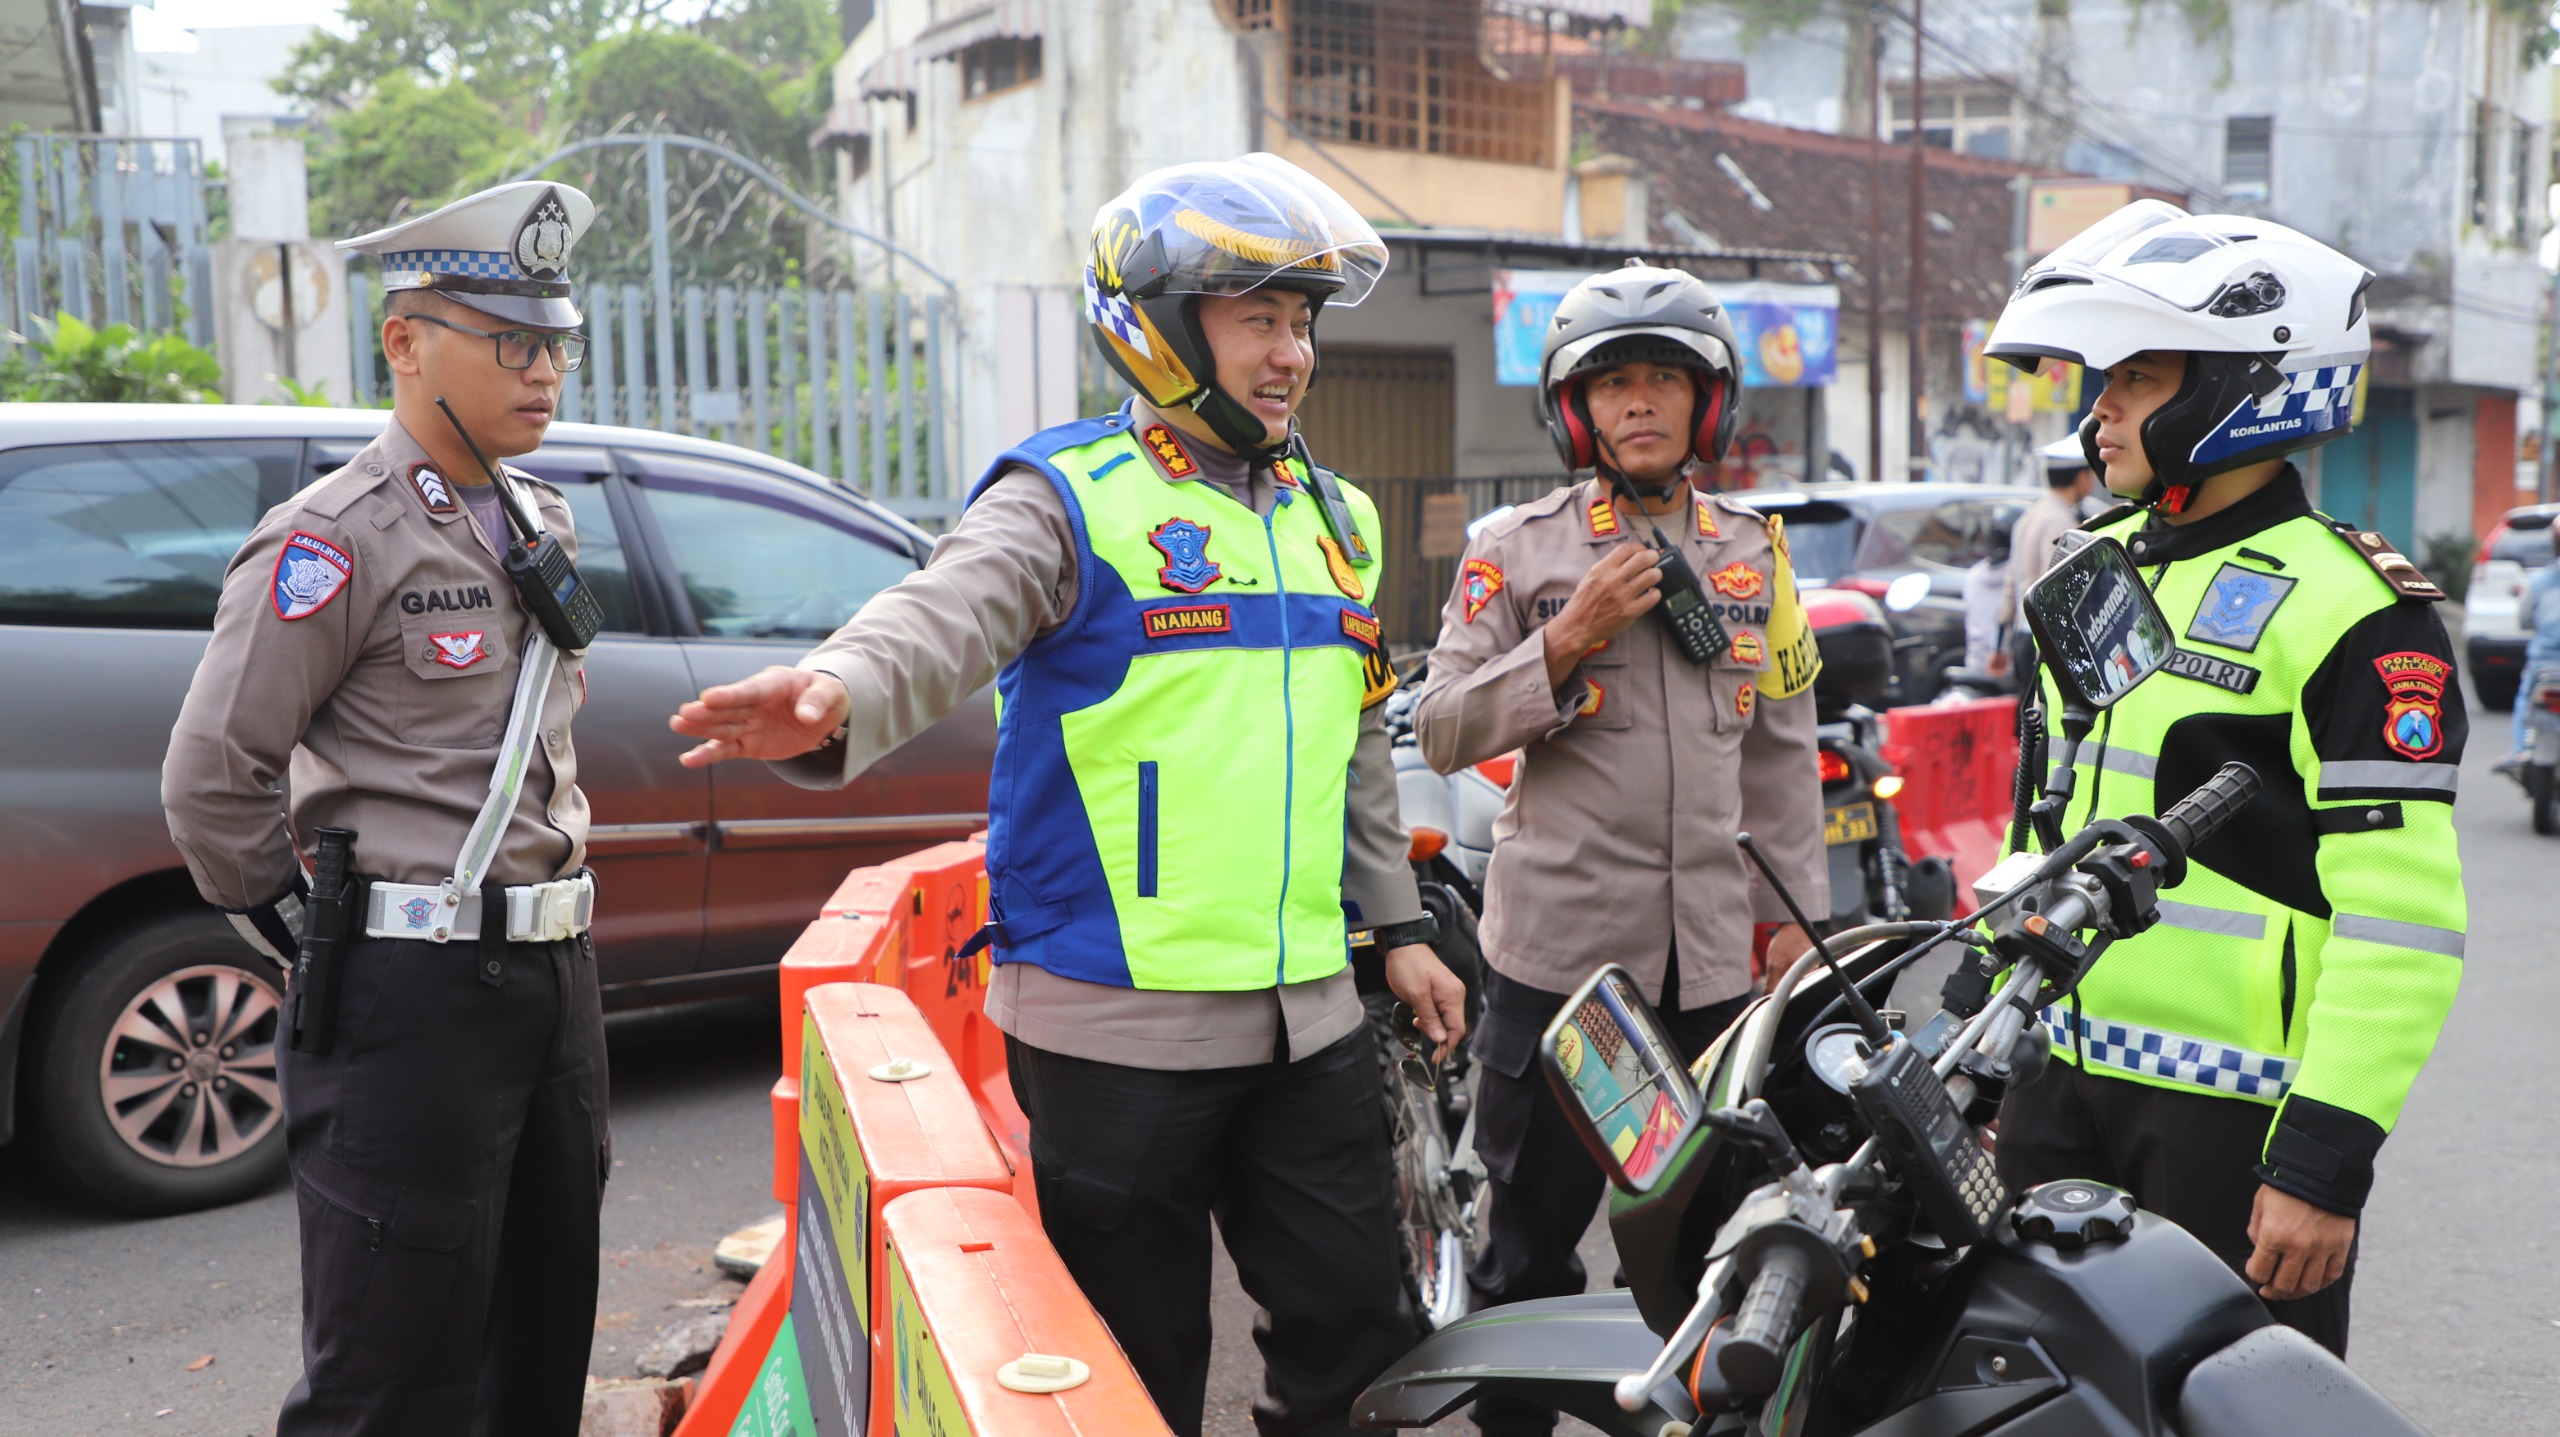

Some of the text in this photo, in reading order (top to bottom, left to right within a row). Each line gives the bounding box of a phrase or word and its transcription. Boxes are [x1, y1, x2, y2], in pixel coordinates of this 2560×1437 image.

[2229, 418, 2302, 438] KORLANTAS
[295, 535, 351, 570] LALU LINTAS
[401, 586, 492, 614] GALUH
[1152, 609, 1224, 631] NANANG
[1713, 603, 1770, 626] POLRI
[2168, 652, 2246, 689] POLRI
[2382, 656, 2444, 675] POLRESTA
[2389, 663, 2437, 675] MALANG
[2392, 680, 2439, 695] JAWA TIMUR
